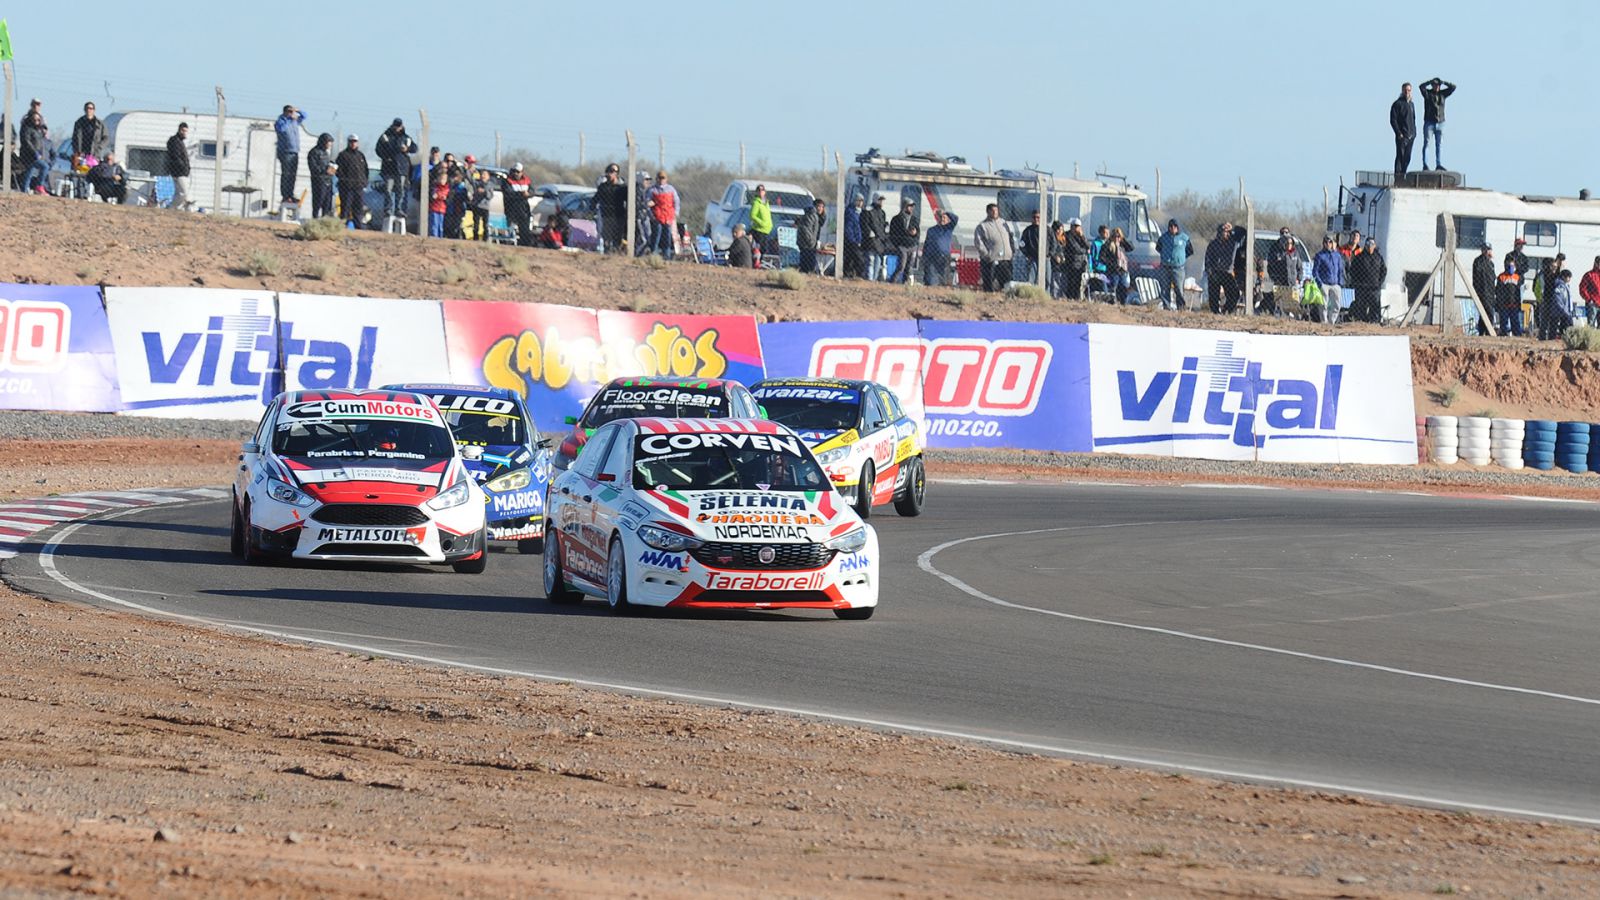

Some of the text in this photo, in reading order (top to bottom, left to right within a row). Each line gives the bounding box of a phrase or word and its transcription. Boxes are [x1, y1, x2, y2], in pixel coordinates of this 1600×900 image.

[603, 389, 721, 406] FloorClean
[752, 388, 844, 399] Avanzar
[324, 400, 434, 419] CumMotors
[640, 433, 803, 458] CORVEN
[700, 495, 806, 511] SELENIA
[705, 571, 826, 590] Taraborelli
